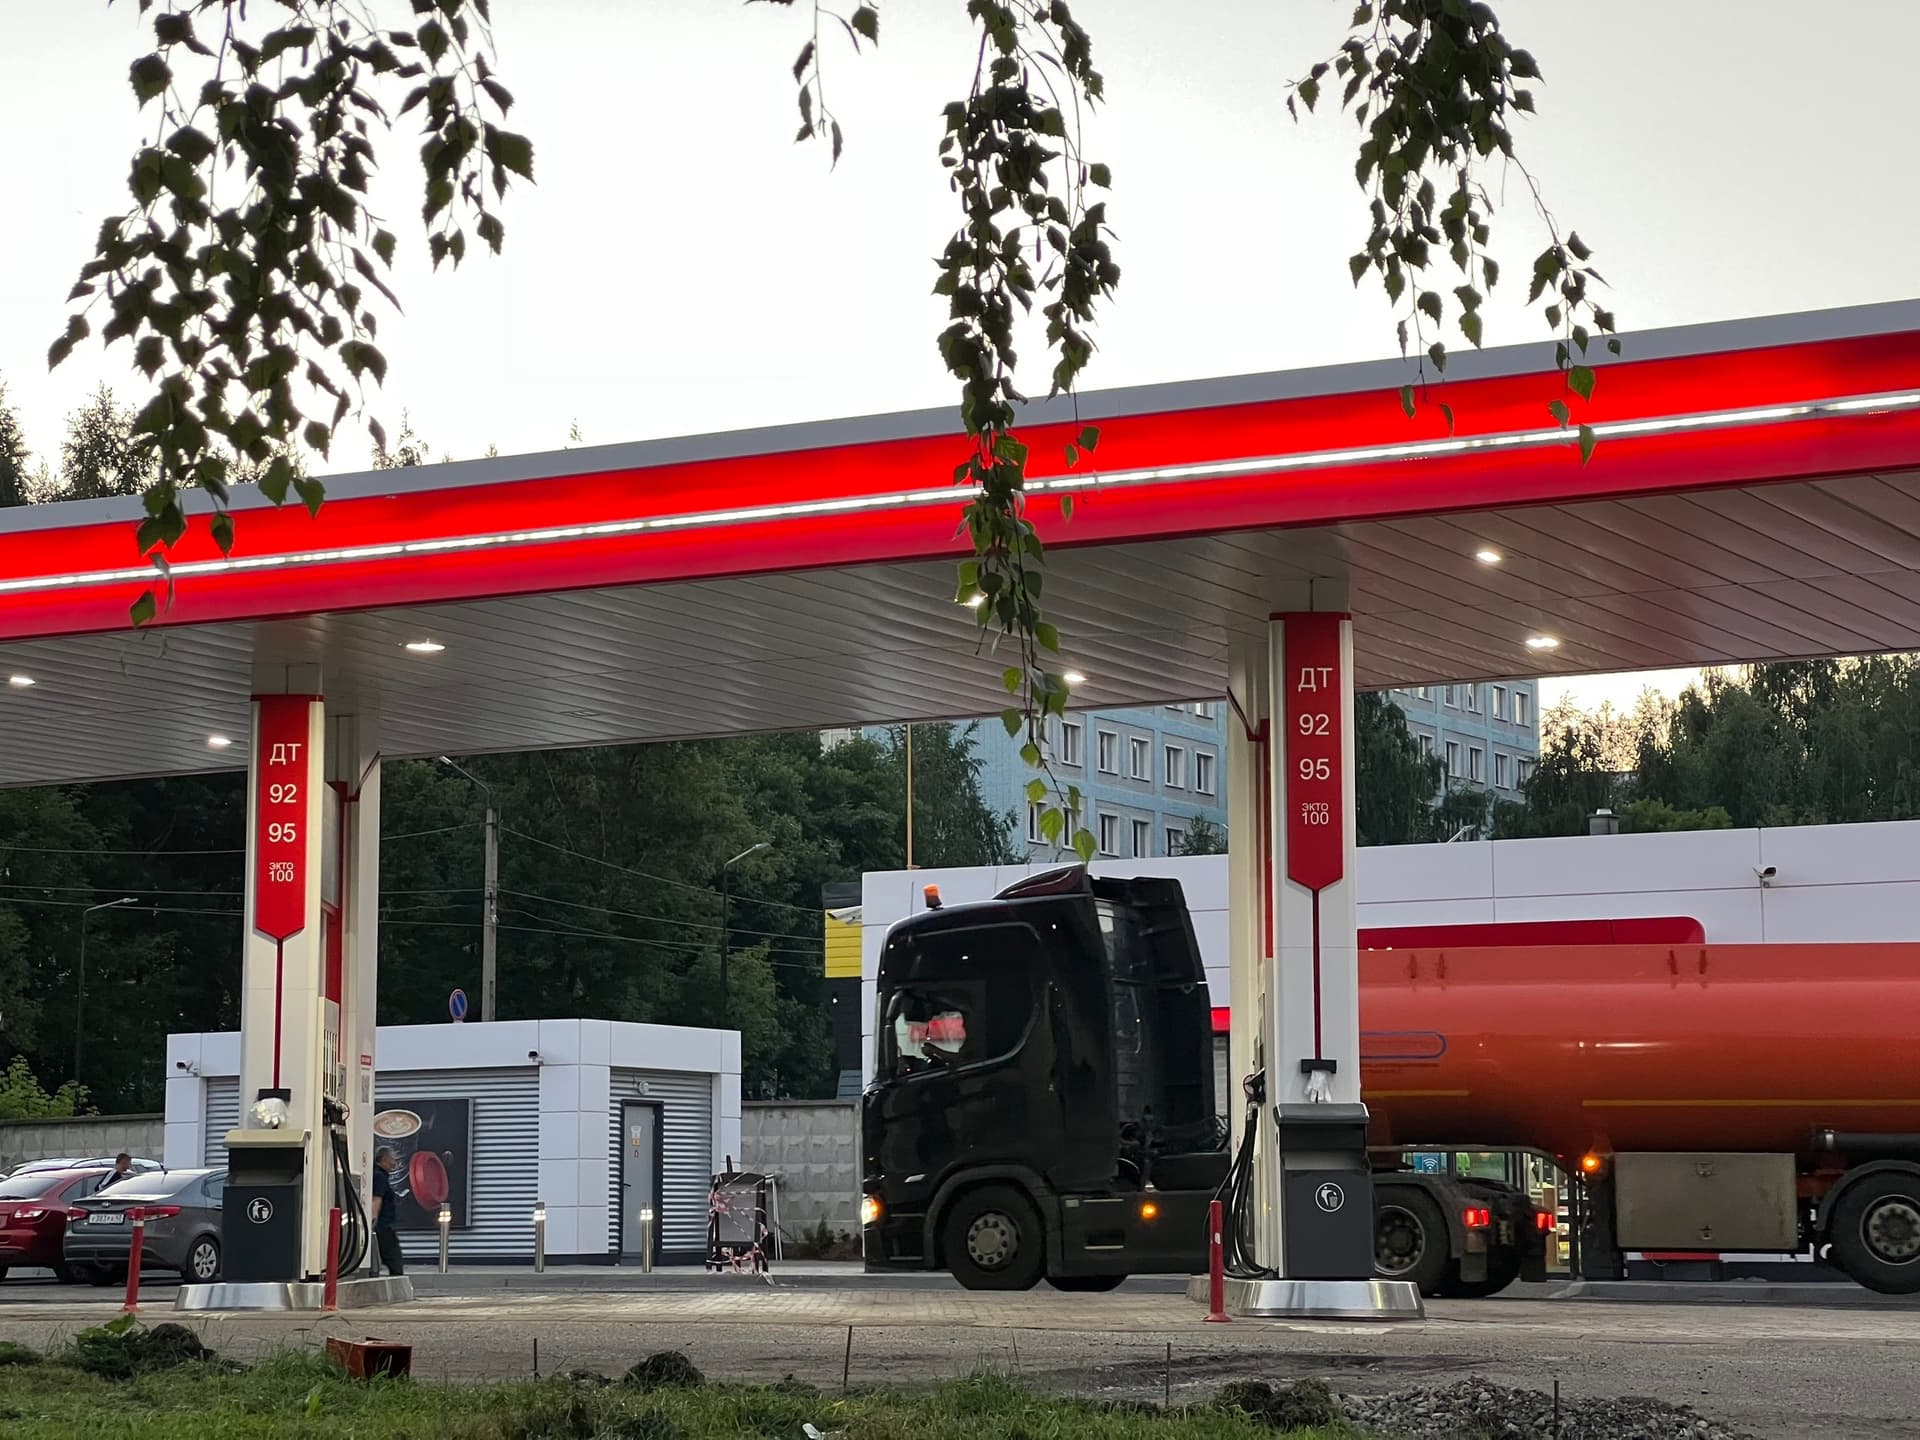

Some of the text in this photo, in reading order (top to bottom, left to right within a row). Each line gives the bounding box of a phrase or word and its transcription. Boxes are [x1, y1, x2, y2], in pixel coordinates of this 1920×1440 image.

[1297, 667, 1333, 692] ДТ
[1299, 713, 1330, 736] 92
[269, 743, 302, 766] ДТ
[1299, 758, 1330, 780] 95
[269, 783, 297, 804] 92
[1301, 803, 1329, 812] ЭКТО
[1301, 812, 1329, 825] 100
[268, 822, 296, 843] 95
[268, 862, 294, 870] ЭКТО
[268, 870, 294, 882] 100
